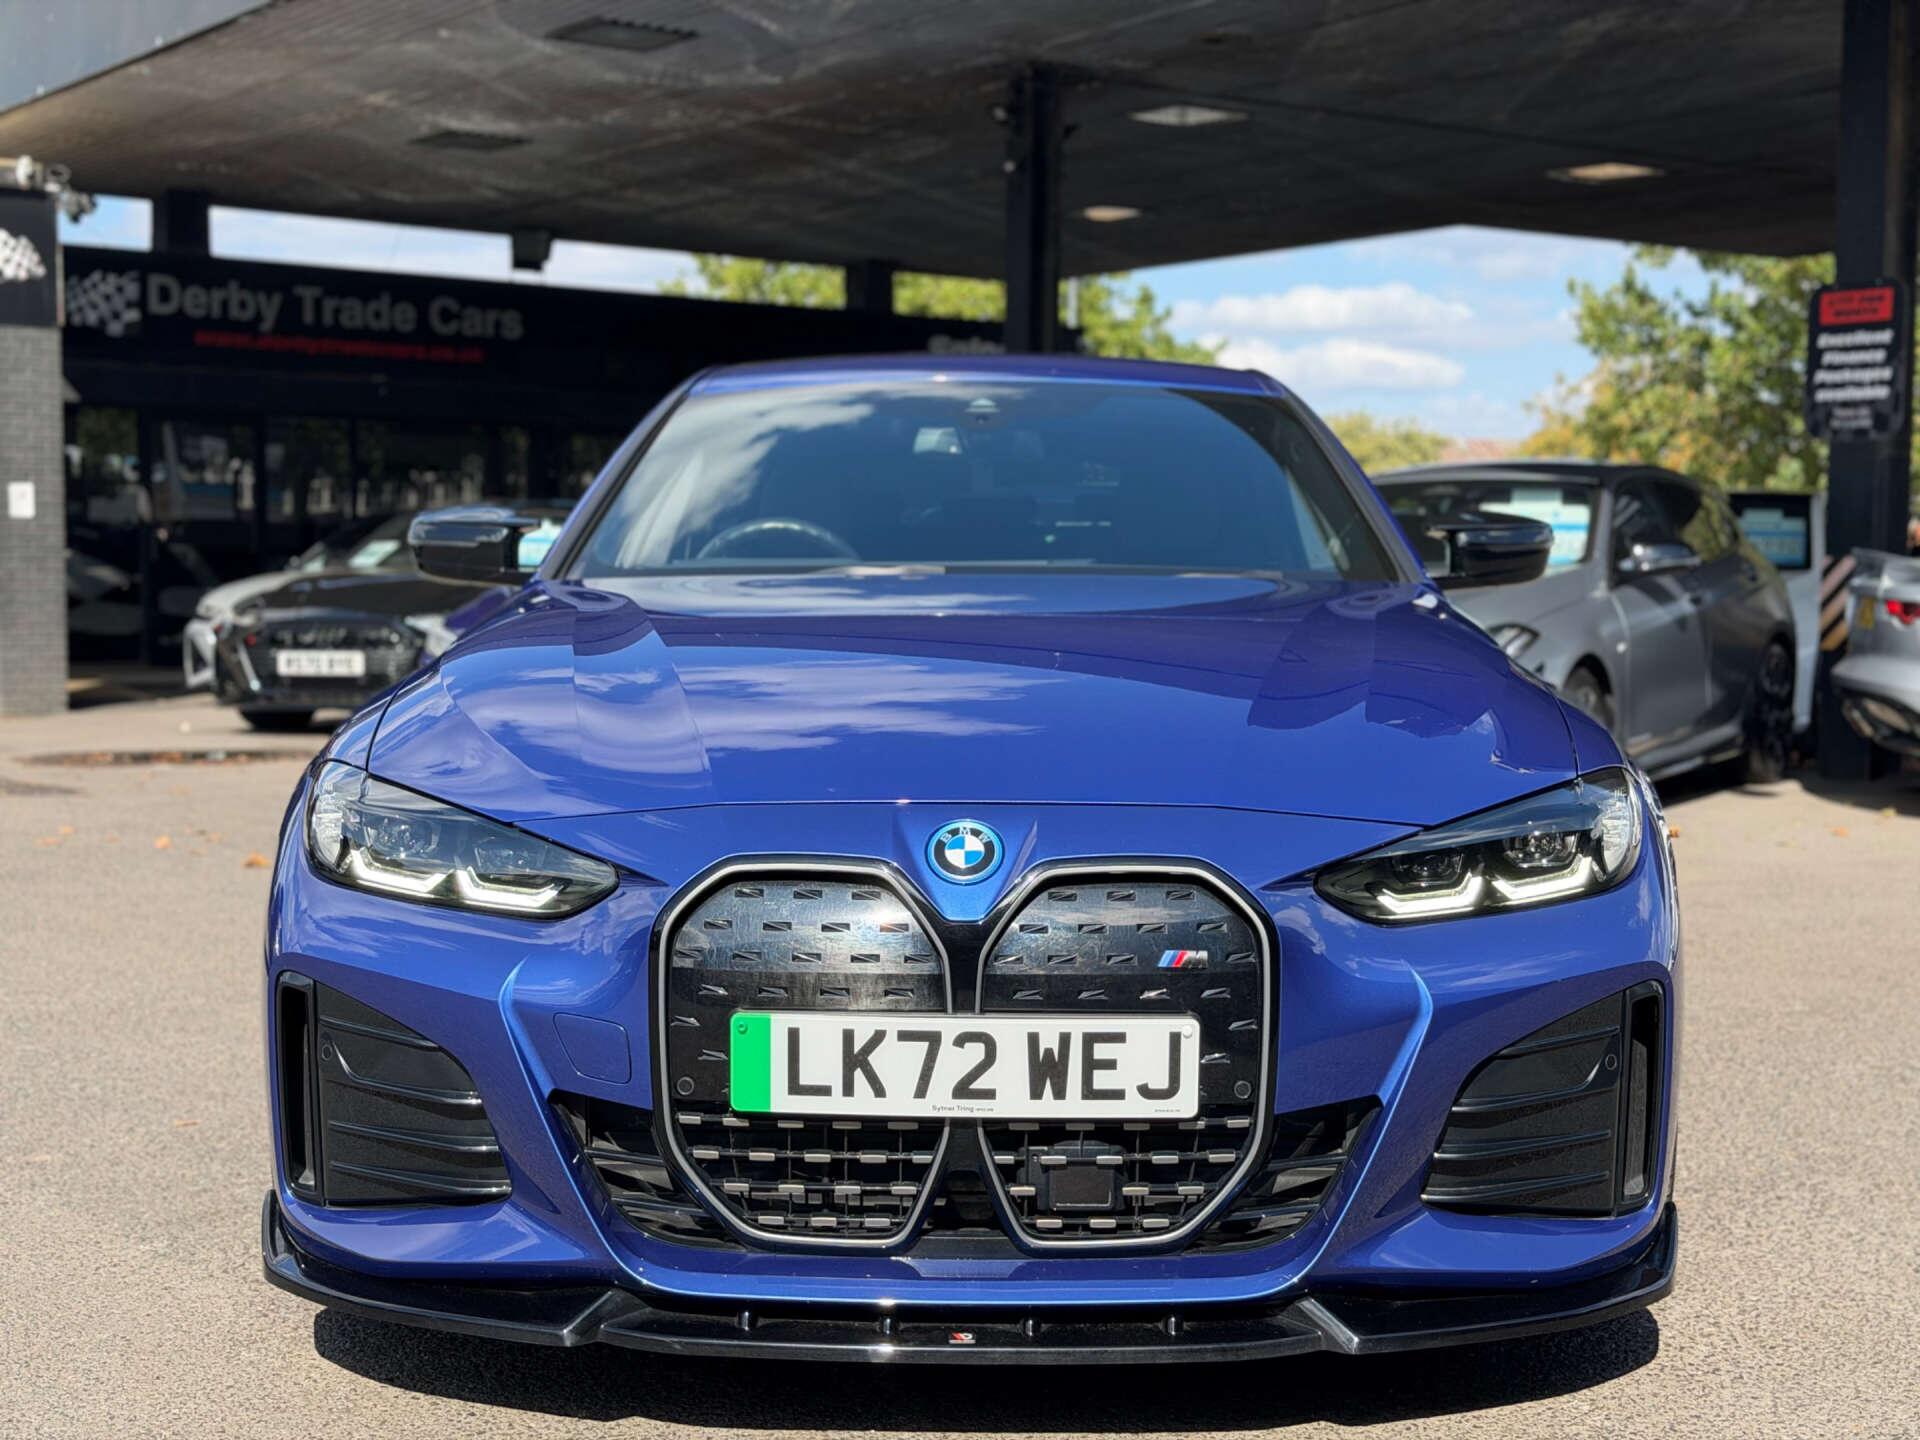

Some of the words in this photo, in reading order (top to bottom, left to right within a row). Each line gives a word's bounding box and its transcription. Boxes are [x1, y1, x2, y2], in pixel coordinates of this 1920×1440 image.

[146, 273, 282, 331] Derby
[293, 286, 416, 333] Trade
[428, 298, 524, 341] Cars
[940, 826, 992, 844] BMW
[787, 1027, 997, 1100] LK72
[1027, 1030, 1183, 1100] WEJ
